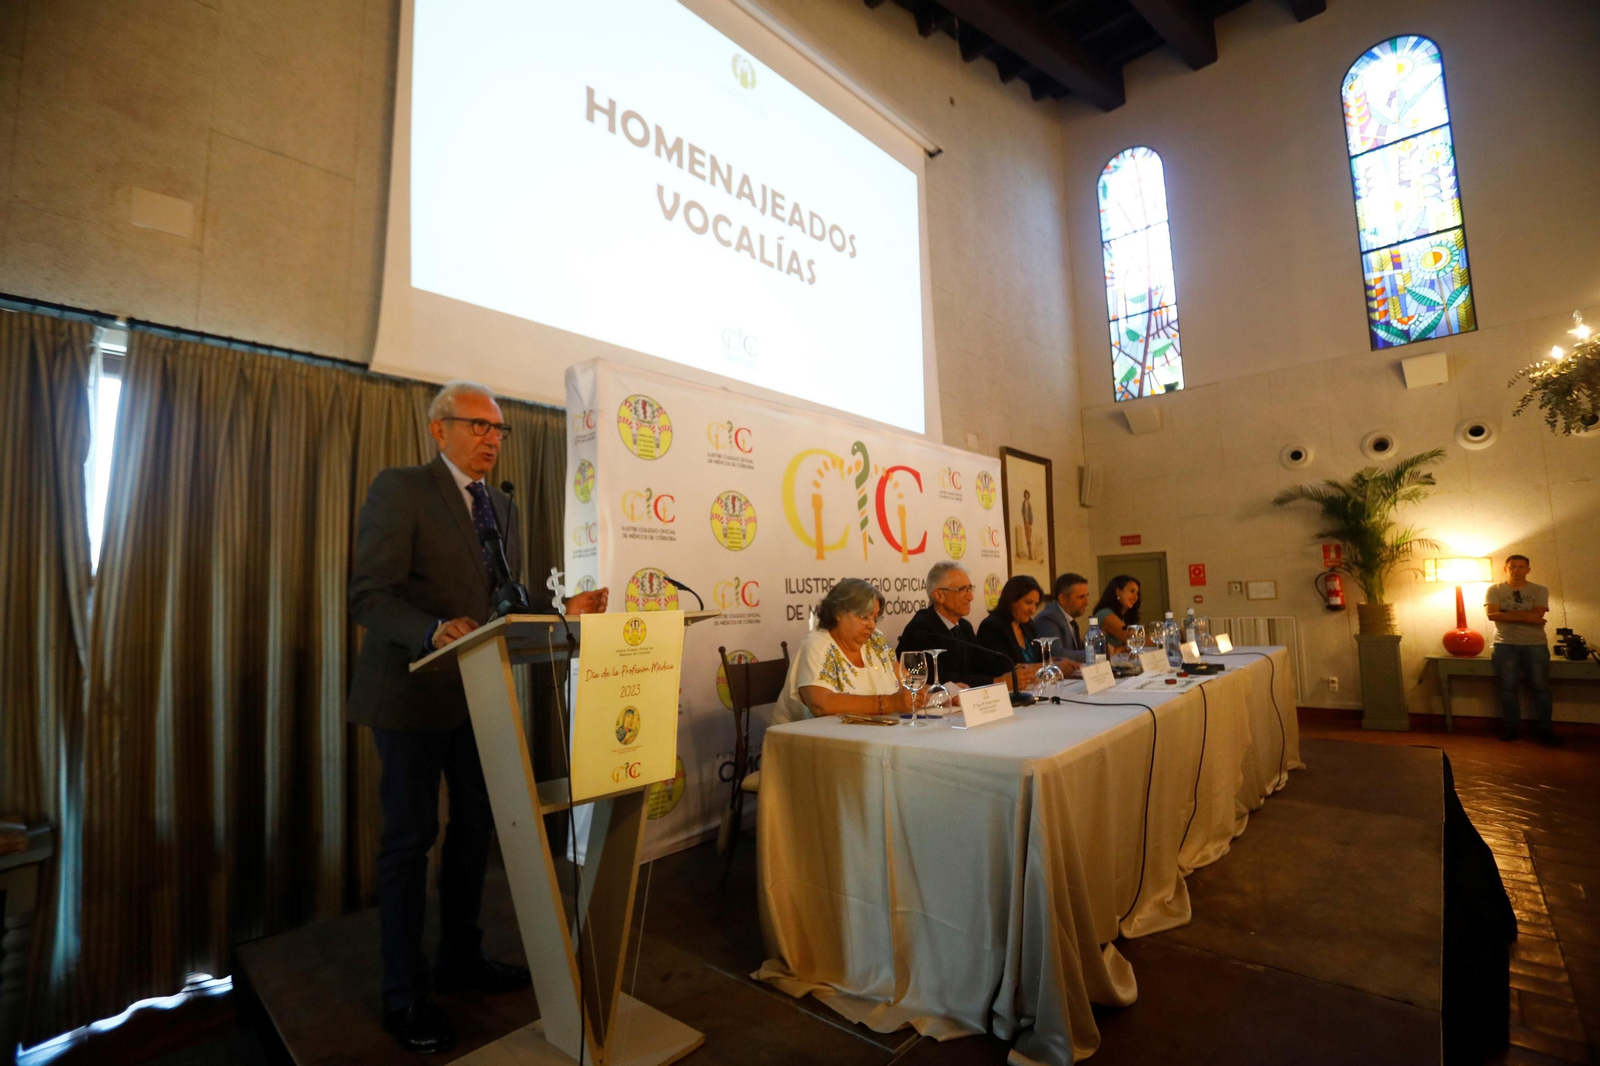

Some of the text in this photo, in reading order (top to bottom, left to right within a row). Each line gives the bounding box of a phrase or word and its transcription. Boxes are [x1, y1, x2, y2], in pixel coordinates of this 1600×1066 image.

[586, 85, 857, 259] HOMENAJEADOS
[656, 183, 817, 285] VOCALÍAS
[785, 577, 835, 594] ILUSTRE
[894, 577, 927, 592] OFICIA
[786, 604, 804, 621] DE
[885, 596, 932, 615] CÓRDOB
[601, 668, 611, 679] de
[620, 684, 641, 698] 2023
